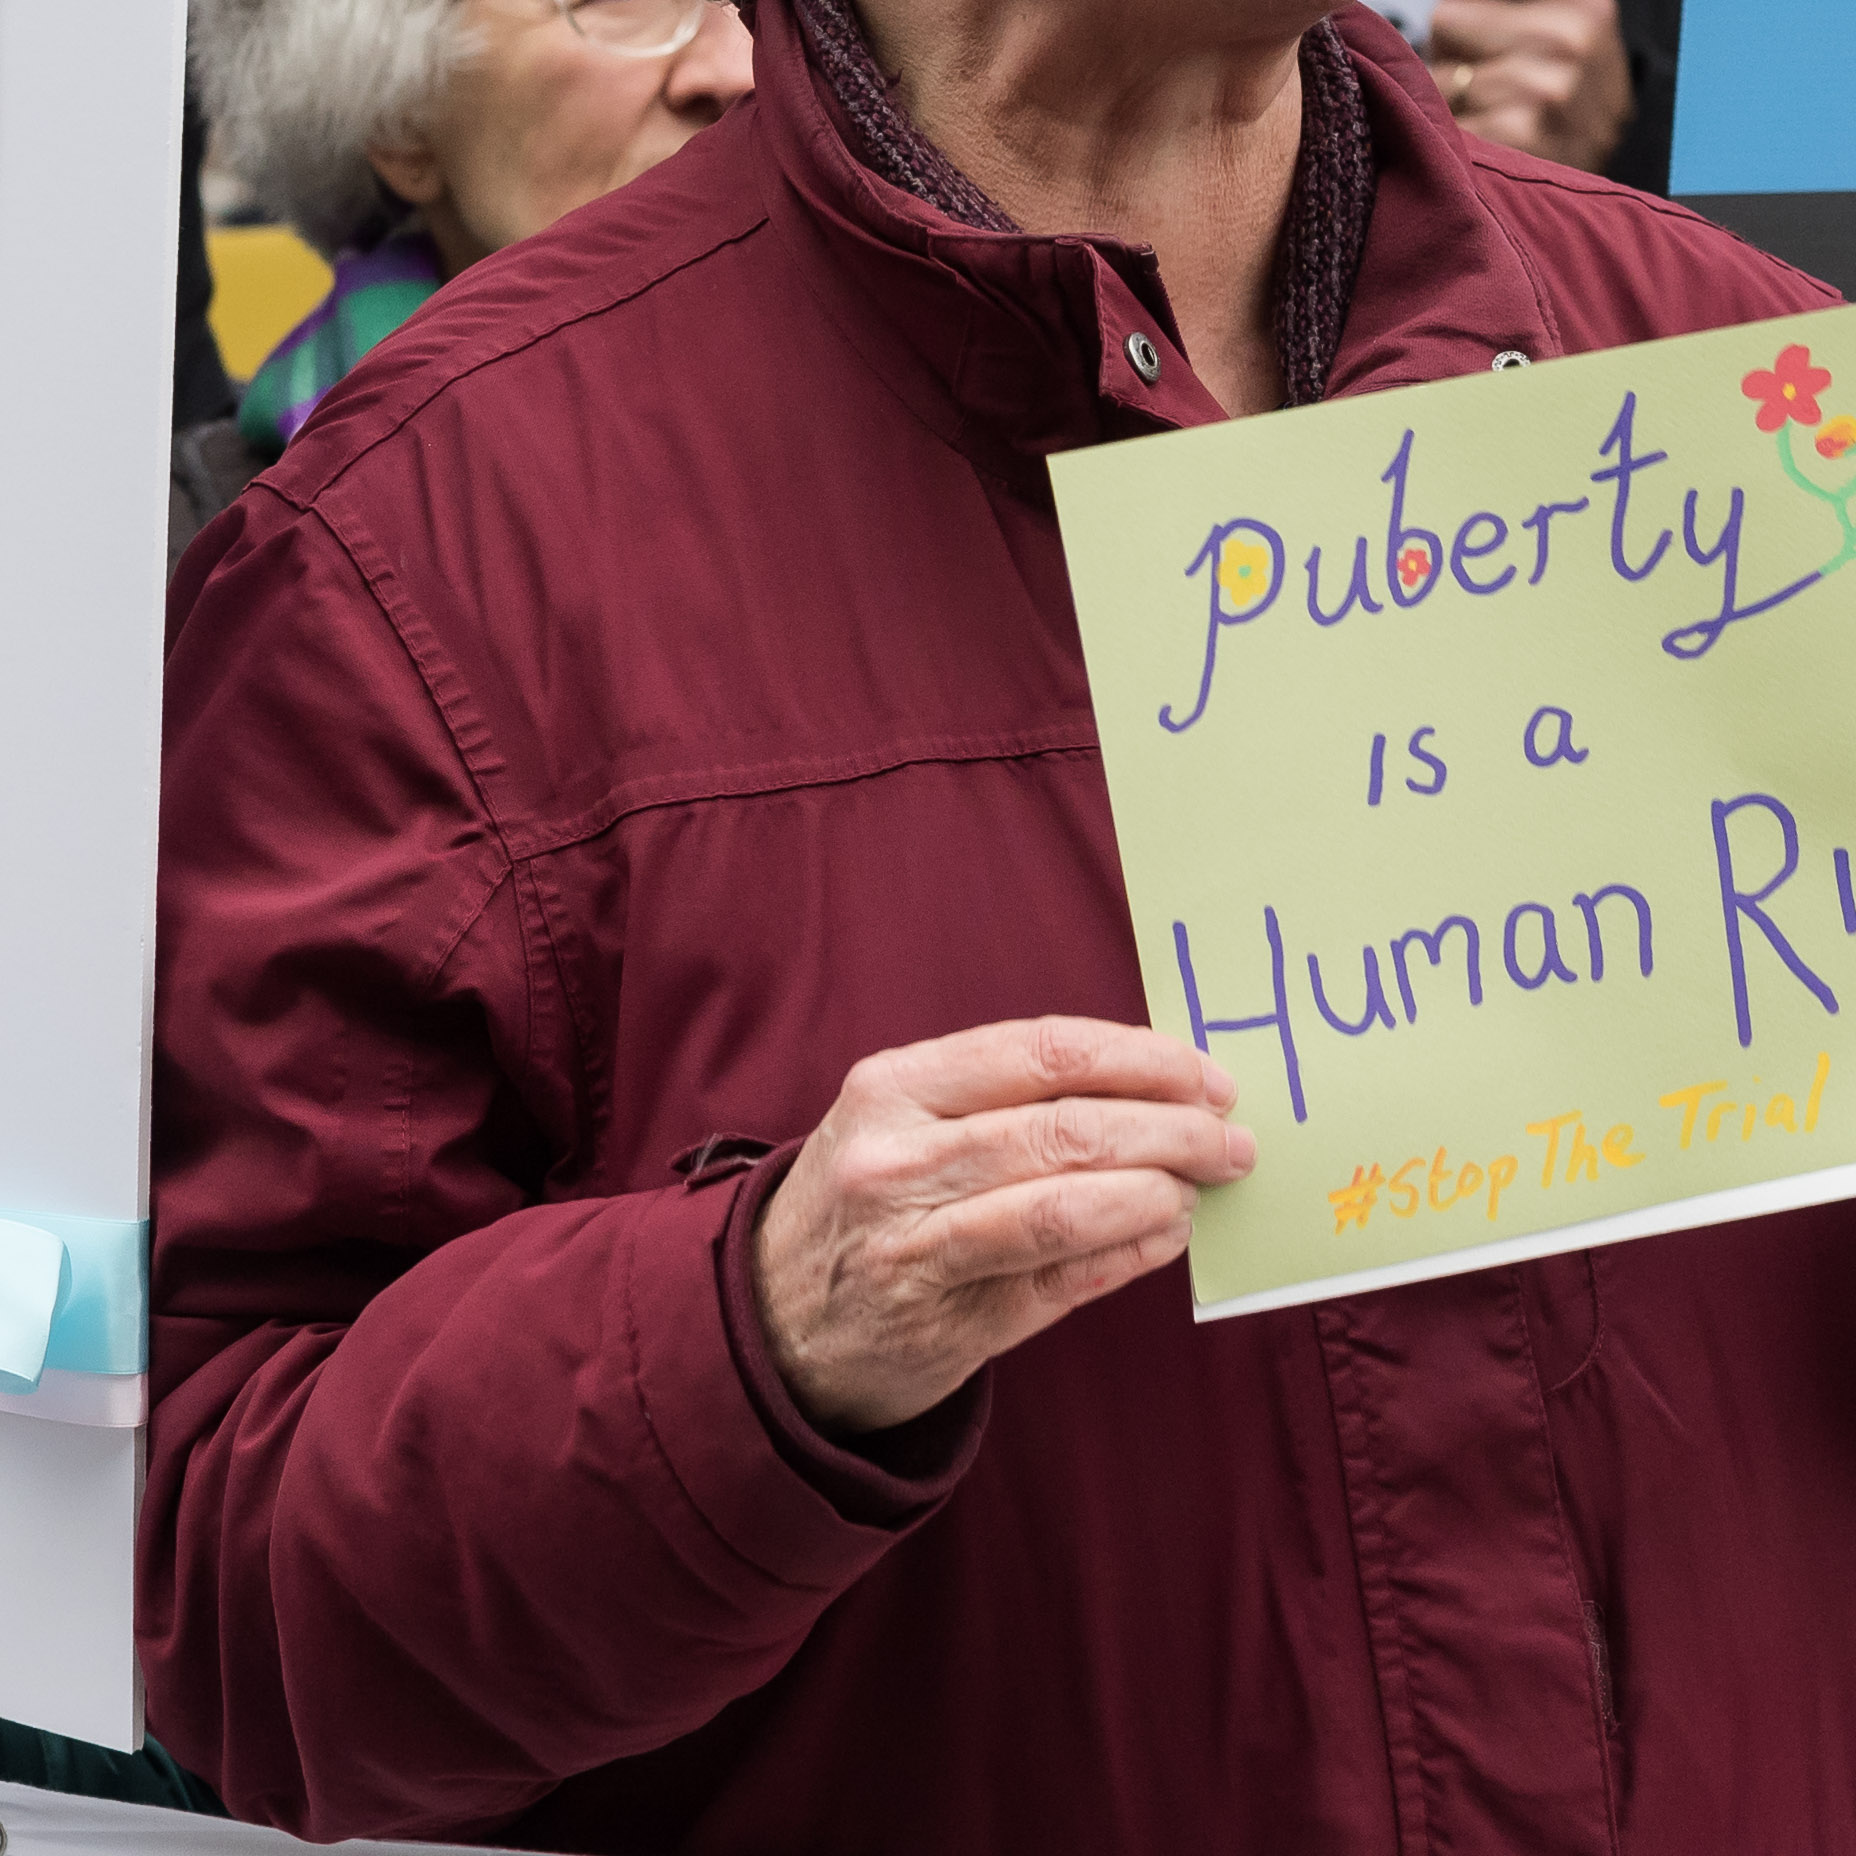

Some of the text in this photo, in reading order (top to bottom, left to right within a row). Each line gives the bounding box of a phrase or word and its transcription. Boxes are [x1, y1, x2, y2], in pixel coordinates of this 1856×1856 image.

[1522, 704, 1591, 768] a
[1171, 883, 1656, 1124] Human
[1525, 1108, 1646, 1189] The
[1658, 1051, 1831, 1150] Trial
